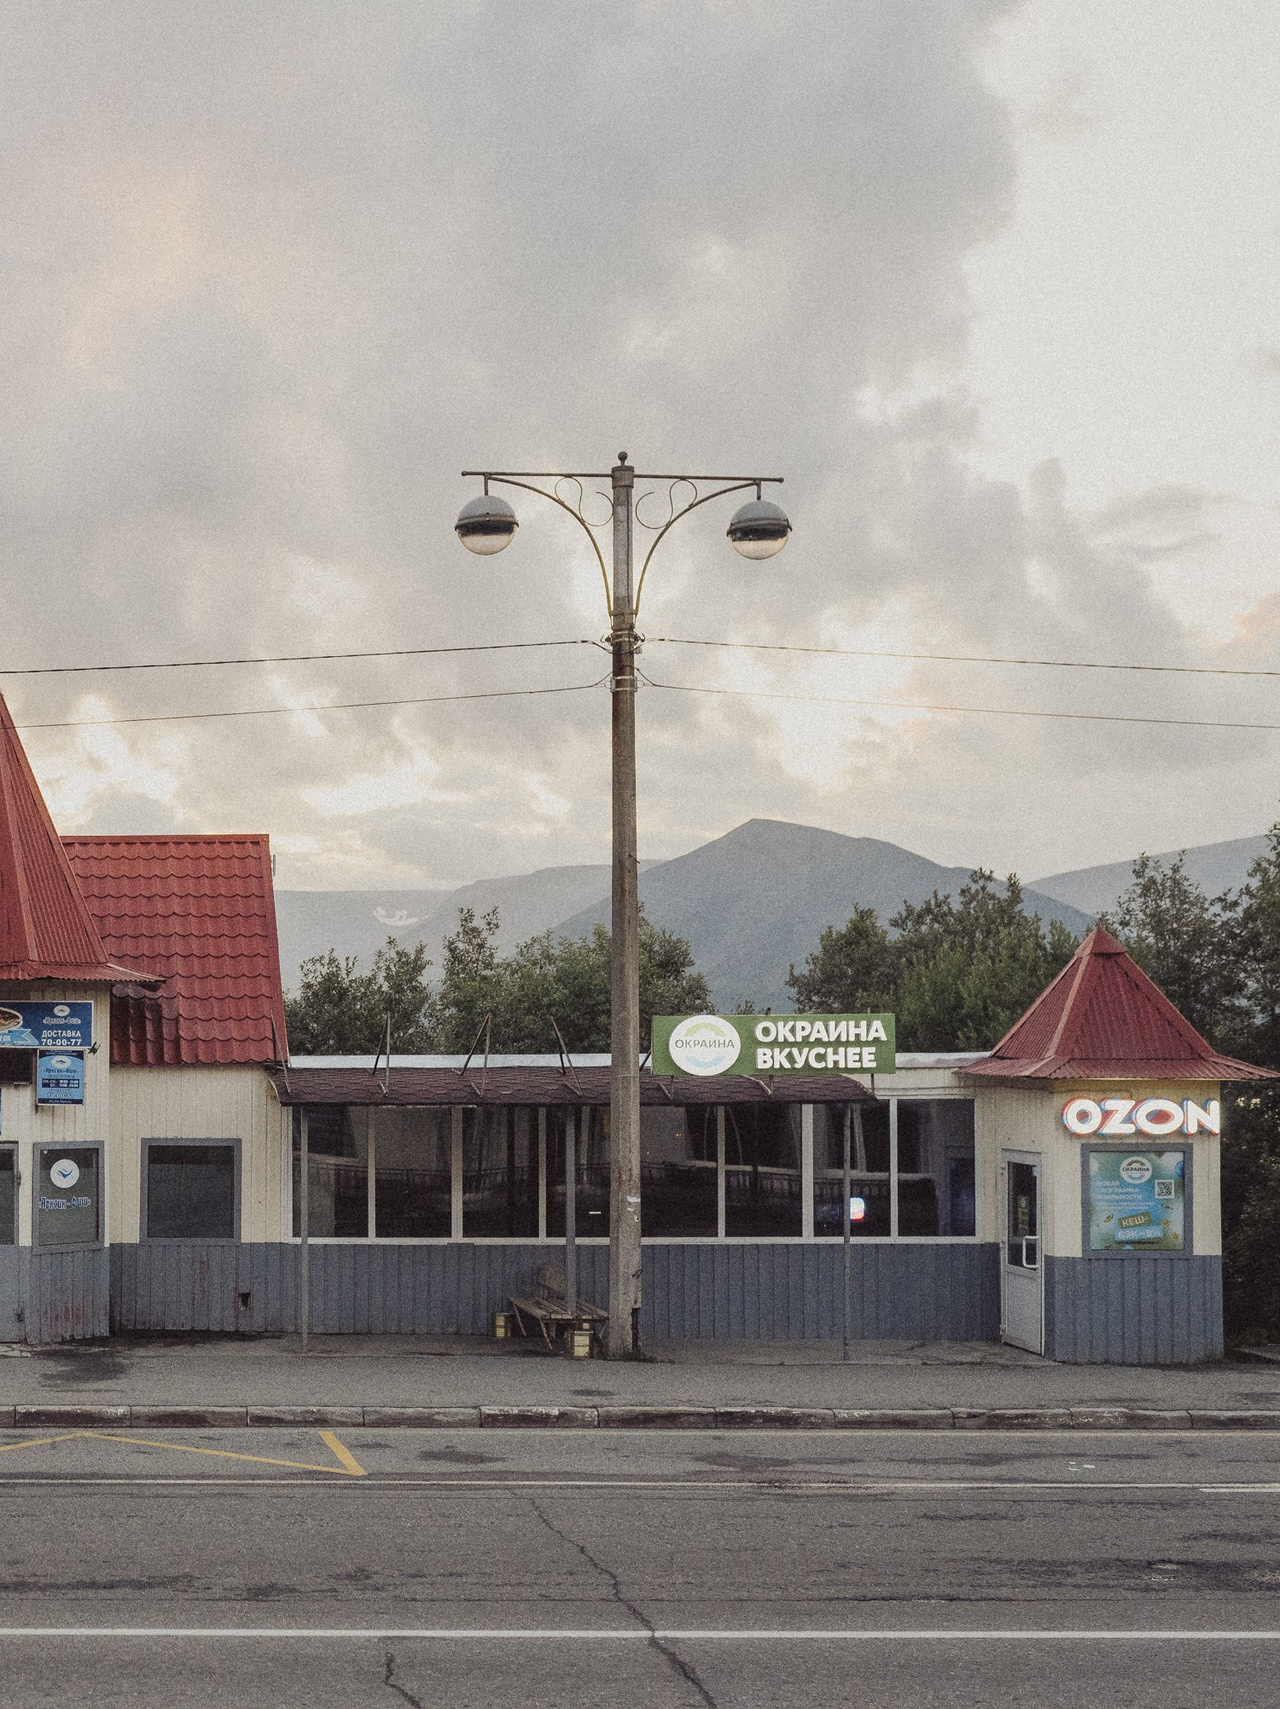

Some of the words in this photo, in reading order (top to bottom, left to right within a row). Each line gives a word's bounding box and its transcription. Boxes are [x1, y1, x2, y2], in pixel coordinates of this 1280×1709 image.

[41, 1030, 81, 1038] ДОСТАВКА
[755, 1020, 888, 1043] ОКРАИНА
[675, 1039, 735, 1049] ОКРАИНА
[756, 1046, 877, 1070] ВКУСНЕЕ
[1061, 1097, 1220, 1136] OZON
